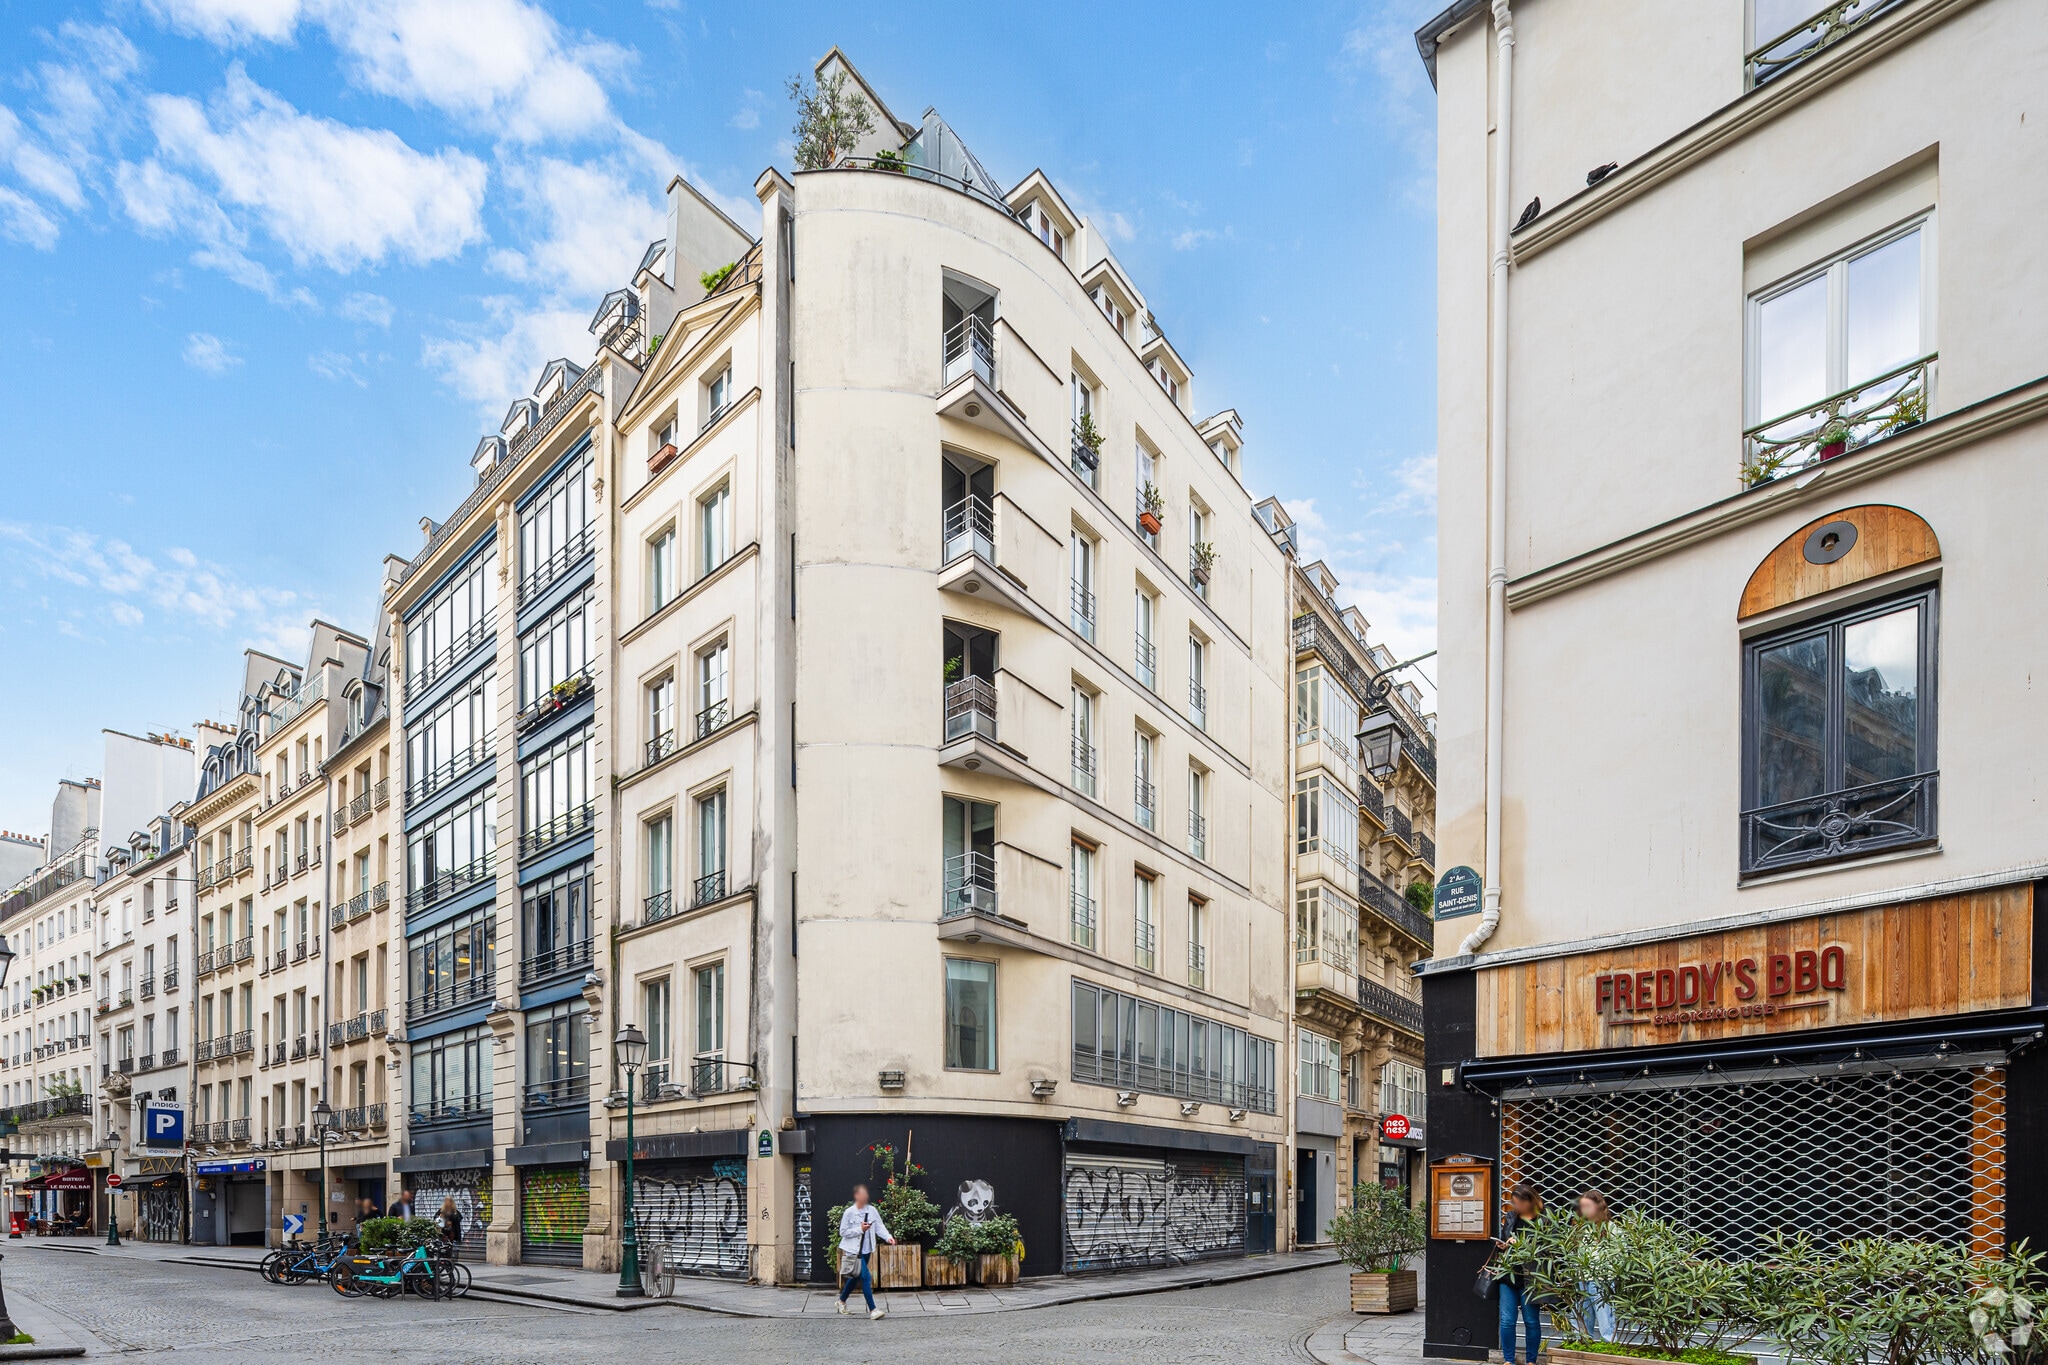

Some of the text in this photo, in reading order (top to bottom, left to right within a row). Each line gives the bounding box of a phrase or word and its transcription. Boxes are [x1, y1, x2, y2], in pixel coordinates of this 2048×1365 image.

[1451, 887, 1464, 896] RUE
[1439, 894, 1478, 909] SAINT-DENIS
[1596, 946, 1845, 1013] FREDDY'S BBQ
[1653, 1003, 1776, 1026] SMOKEHOUSE
[152, 1101, 180, 1109] INDIGO
[156, 1113, 176, 1134] P
[1386, 1119, 1405, 1127] neo
[1386, 1126, 1407, 1134] ness
[256, 1161, 264, 1169] P
